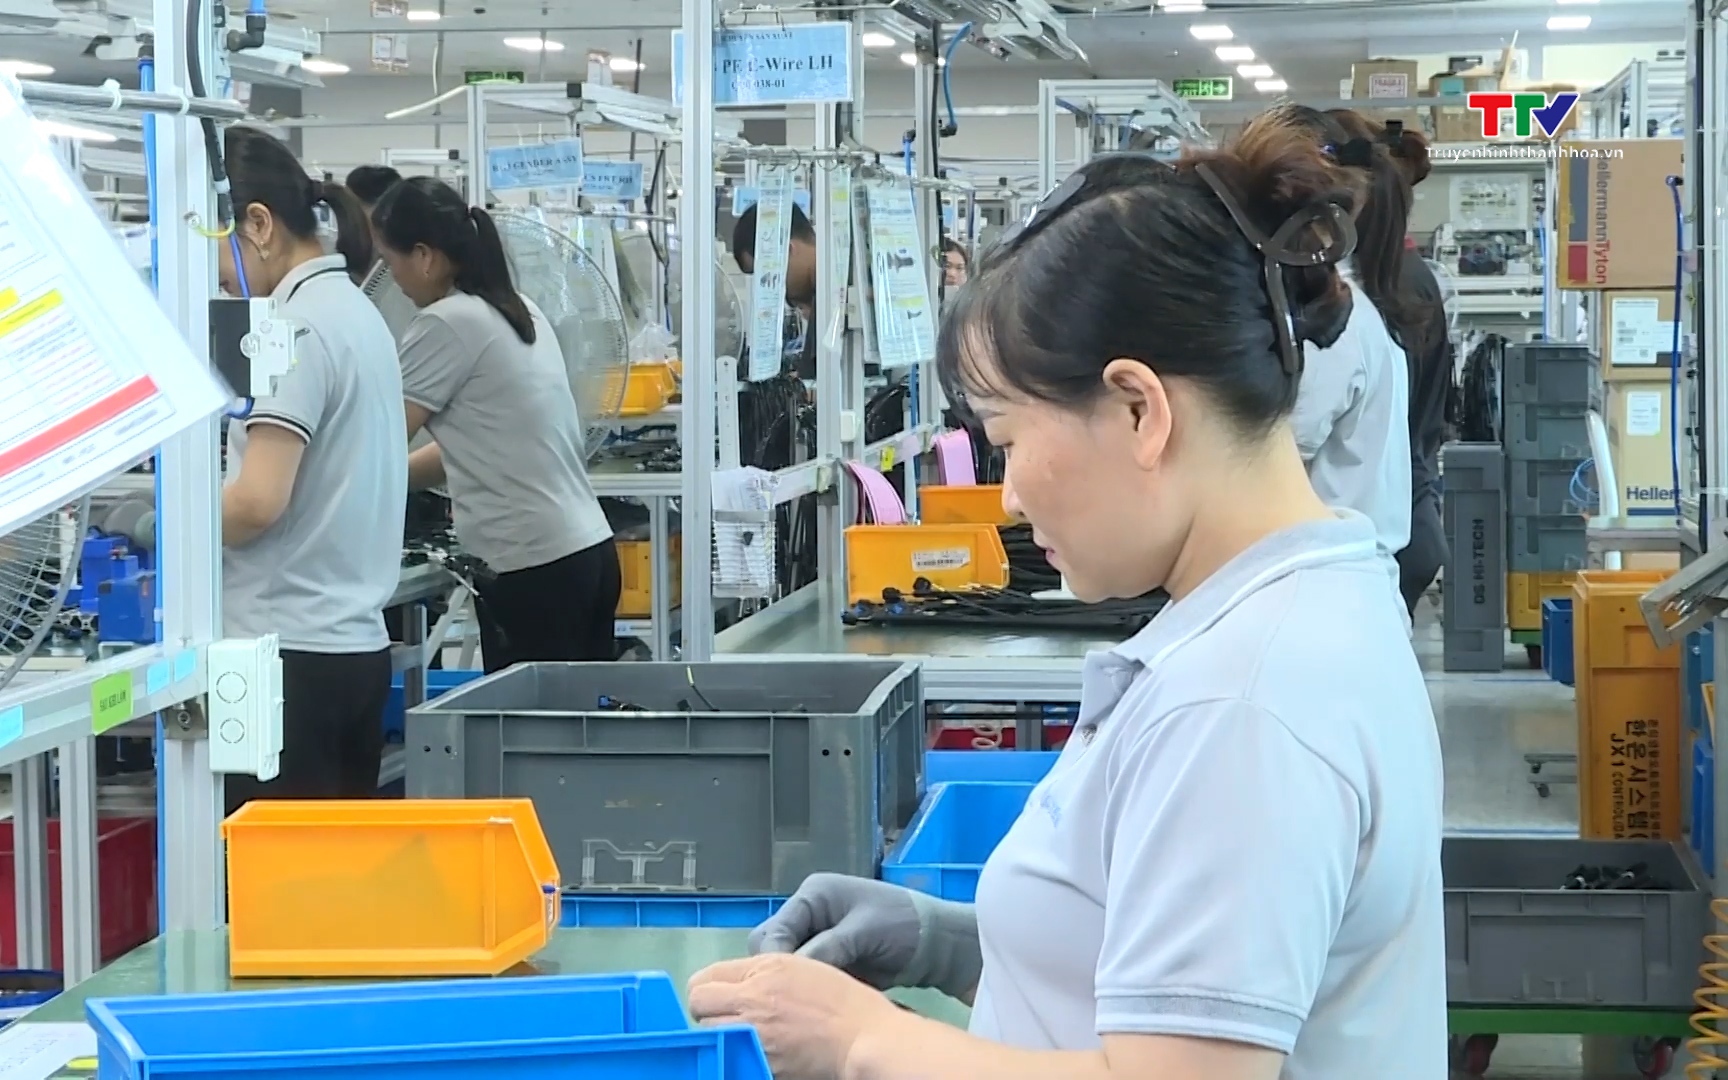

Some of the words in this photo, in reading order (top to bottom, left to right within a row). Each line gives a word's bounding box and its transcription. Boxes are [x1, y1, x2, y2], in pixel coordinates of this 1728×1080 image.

[808, 54, 833, 70] LH
[1472, 518, 1485, 580] HI-TECH
[1610, 733, 1626, 767] JX1
